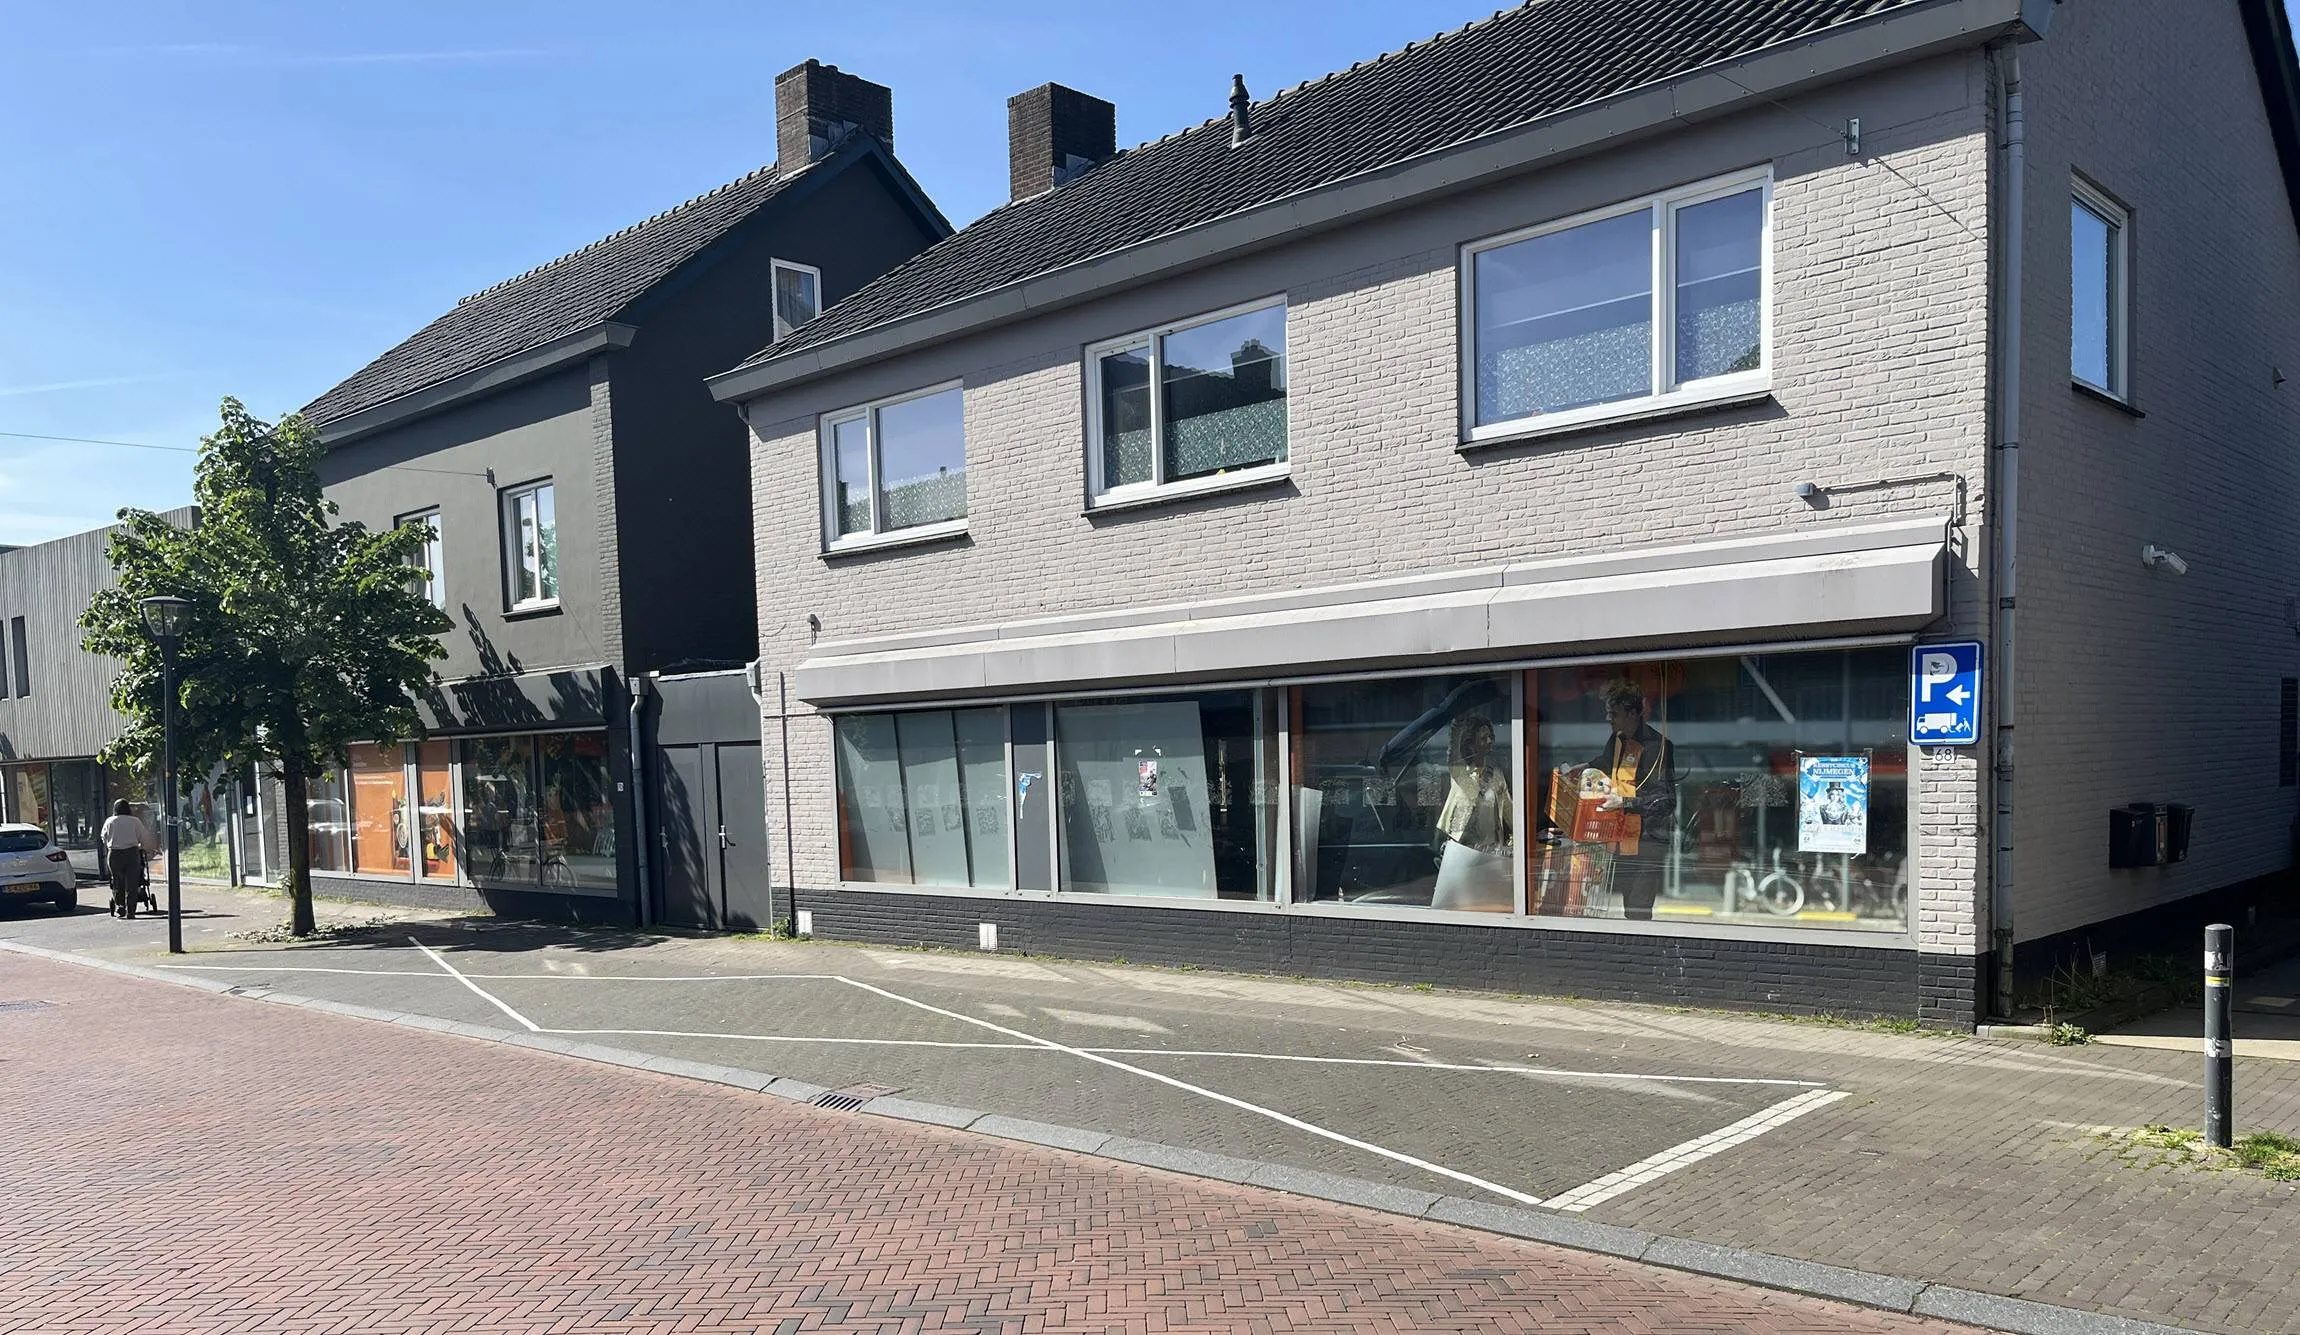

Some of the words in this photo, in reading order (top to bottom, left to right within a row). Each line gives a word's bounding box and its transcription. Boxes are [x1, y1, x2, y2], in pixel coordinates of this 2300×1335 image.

[1921, 653, 1957, 702] P
[1935, 749, 1952, 761] 68
[1812, 768, 1855, 776] NIJMEGEN
